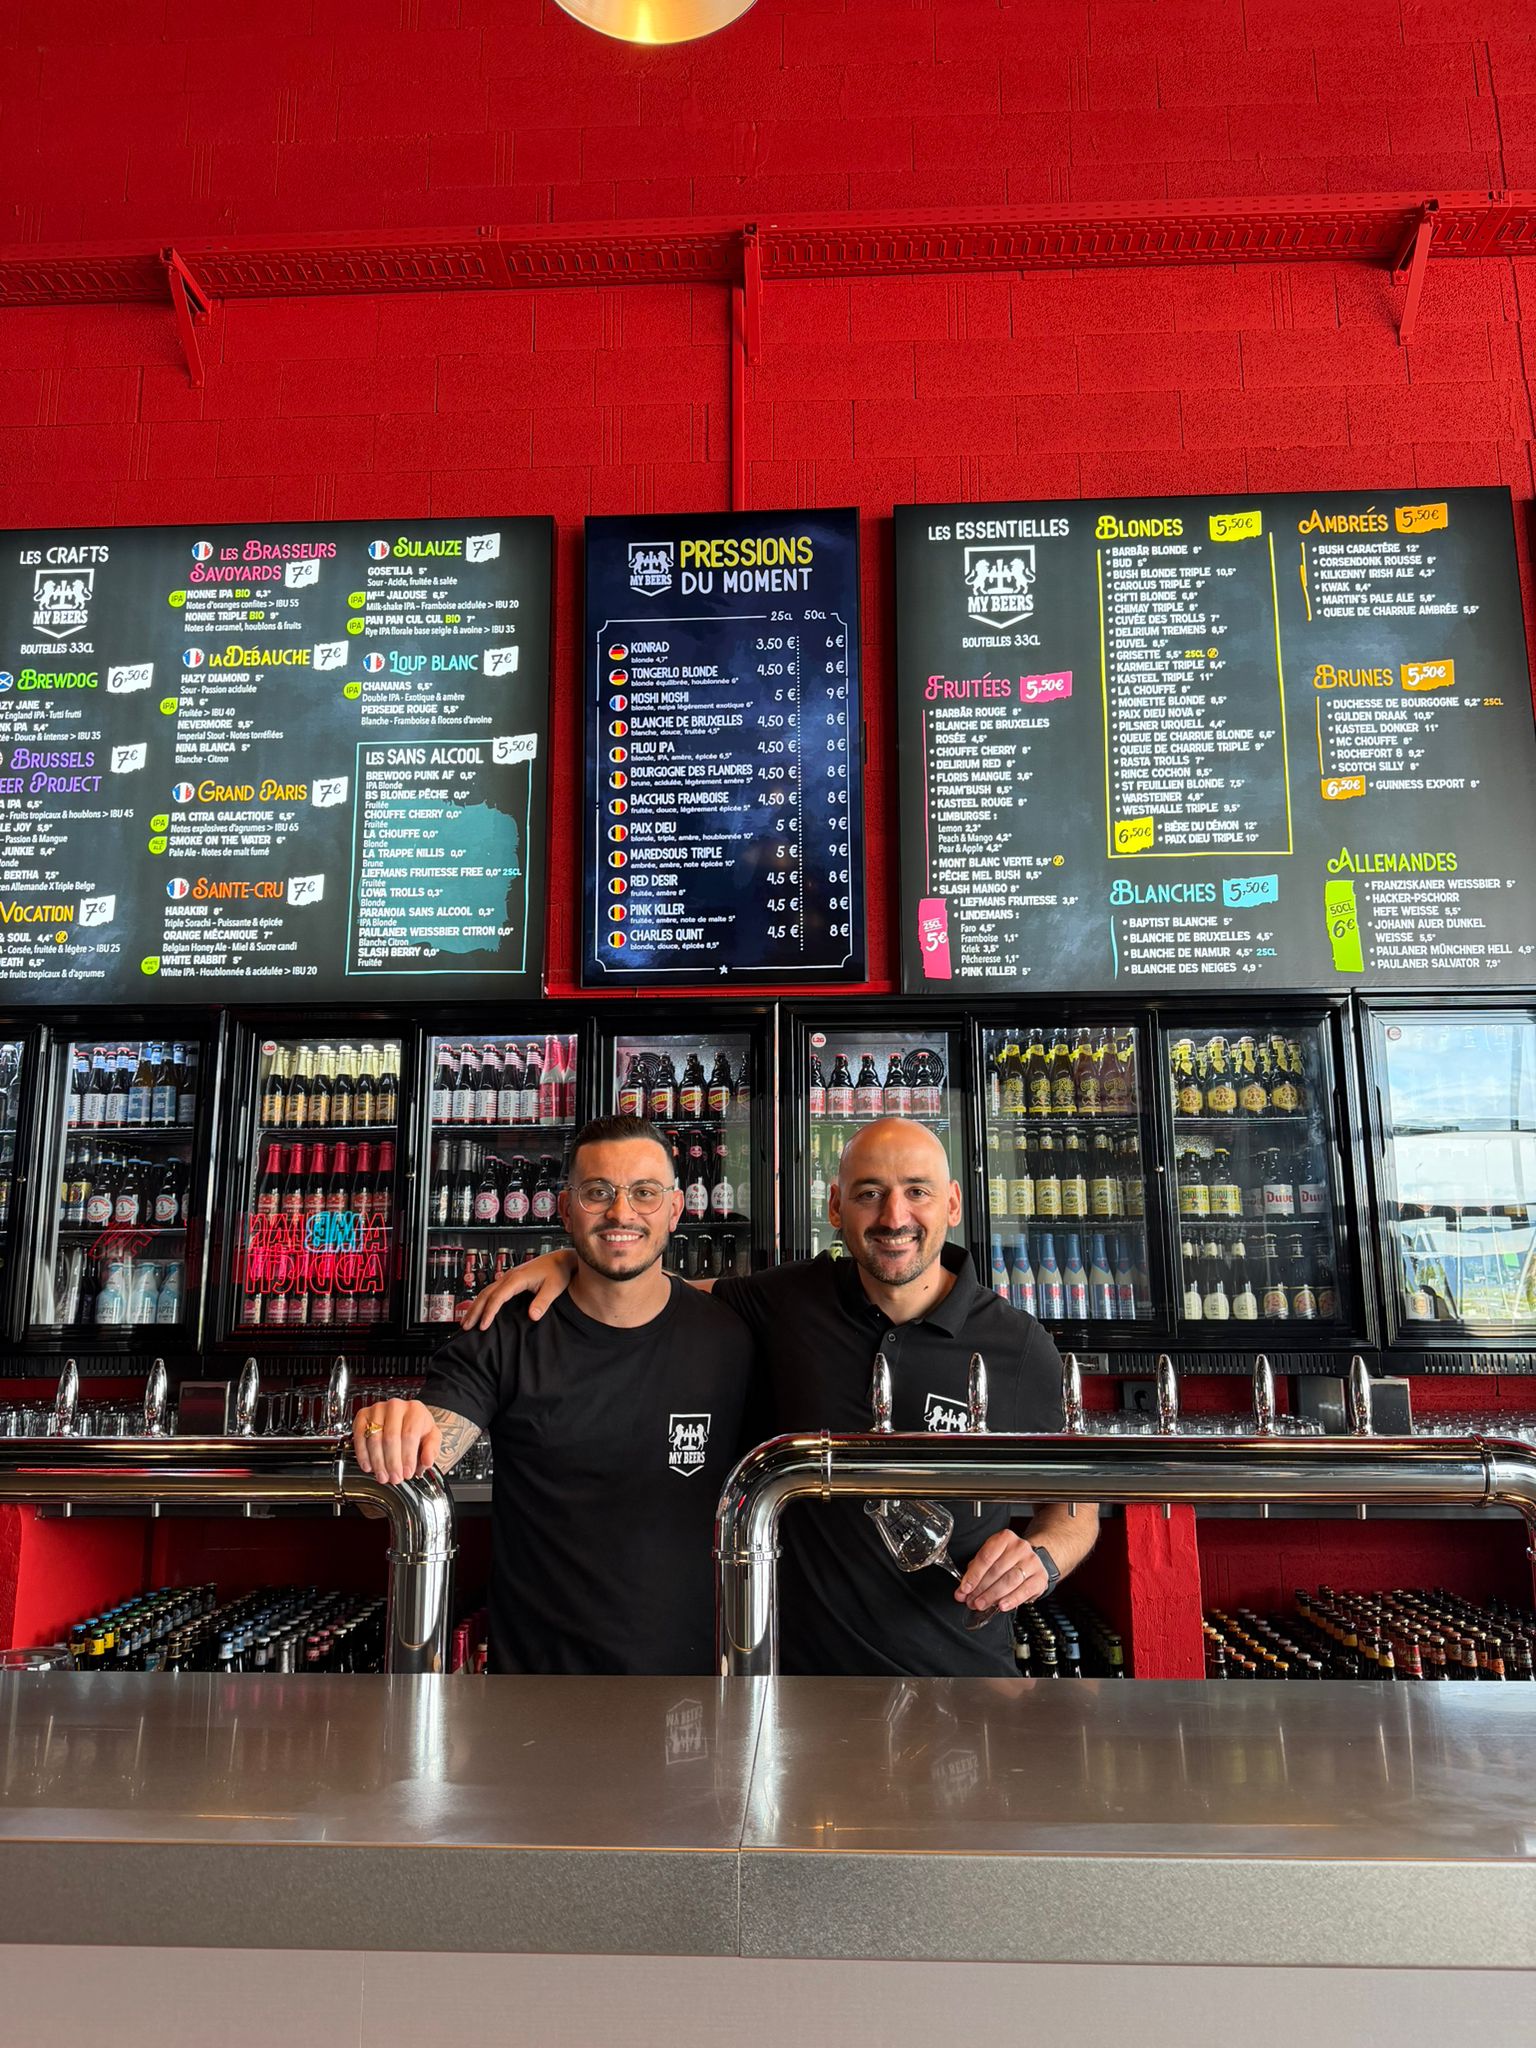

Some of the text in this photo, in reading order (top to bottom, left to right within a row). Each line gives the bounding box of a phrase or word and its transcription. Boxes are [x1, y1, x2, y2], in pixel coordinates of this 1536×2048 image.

[928, 518, 1070, 540] LES ESSENTIELLES
[1095, 516, 1183, 539] BLONDES
[220, 540, 337, 561] LES BRASSEURS
[393, 537, 463, 558] SULAUZE
[473, 539, 494, 558] 7€
[680, 536, 813, 568] PRESSIONS
[20, 546, 109, 564] LES CRAFTS
[190, 562, 282, 582] SAVOYARDS
[292, 565, 312, 583] 7€
[630, 574, 672, 586] MY BEERS
[681, 567, 813, 595] DU MOMENT
[1321, 582, 1350, 592] KWAK
[171, 594, 183, 603] IPA
[187, 590, 217, 599] NONNE
[219, 589, 233, 599] IPA
[235, 589, 250, 598] BIO
[1322, 593, 1414, 605] MARTIN'S PALE ALE
[968, 594, 1033, 613] MY BEERS
[33, 610, 88, 625] MY BEERS
[20, 643, 67, 655] BOUTEILLES
[631, 641, 670, 654] KONRAD
[962, 637, 1012, 648] BOUTEILLES
[1116, 639, 1147, 648] DUVEL
[209, 654, 222, 667] LA
[320, 647, 341, 666] 7€
[389, 651, 479, 676] LOUP BLANC
[491, 653, 512, 672] 7€
[17, 669, 98, 690] BREWDOG
[181, 674, 206, 683] HAZY
[208, 673, 250, 683] DIAMOND
[631, 667, 680, 679] TONGERLO
[682, 666, 719, 678] BLONDE
[1313, 664, 1394, 689] BRUNES
[362, 682, 412, 691] CHANANAS
[925, 672, 1012, 700] FRUITÉES
[631, 692, 689, 704] MOSHI MOSHI
[1333, 699, 1383, 709] DUCHESSE
[1386, 699, 1399, 708] DE
[1401, 697, 1459, 708] BOURGOGNE
[406, 704, 438, 714] ROUGE
[630, 714, 743, 729] BLANCHE DE BRUXELLES
[1119, 720, 1204, 731] PILSNER URQUELL
[630, 741, 675, 754] FILOU IPA
[10, 748, 95, 769] BRUSSELS
[117, 749, 139, 769] 7€
[365, 747, 484, 766] LES SANS ALCOOL
[630, 764, 753, 778] BOURGOGNE DES FLANDRES
[0, 771, 102, 794] EER PROJECT
[1376, 779, 1464, 790] GUINNESS EXPORT
[197, 779, 307, 802] GRAND PARIS
[320, 783, 341, 803] 7€
[630, 792, 729, 806] BACCHUS FRAMBOISE
[630, 822, 677, 834] PAIX DIEU
[630, 847, 723, 861] MAREDSOUS TRIPLE
[1326, 847, 1457, 873] ALLEMANDES
[939, 856, 1033, 868] MONT BLANC VERTE
[361, 868, 408, 878] LIEFMANS
[409, 867, 459, 877] FRUITESSE
[460, 867, 484, 877] FREE
[630, 874, 678, 887] RED DESIR
[1371, 880, 1445, 890] FRANZISKANER
[1447, 879, 1501, 889] WEISSBIER
[192, 877, 284, 899] SAINTE-CRU
[294, 881, 316, 901] 7€
[1110, 880, 1216, 905] BLANCHES
[1372, 893, 1459, 903] HACKER-PSCHORR
[0, 901, 74, 924] VOCATION
[86, 902, 107, 922] 7€
[630, 903, 685, 916] PINK KILLER
[1330, 903, 1353, 915] 50CL
[1129, 917, 1169, 927] BAPTIST
[1172, 917, 1217, 926] BLANCHE
[1332, 918, 1355, 939] 6€
[163, 928, 258, 941] ORANGE MÉCANIQUE
[358, 927, 407, 938] PAULANER
[410, 927, 460, 937] WEISSBIER
[462, 926, 496, 936] CITRON
[629, 928, 704, 942] CHARLES QUINT
[925, 931, 947, 952] 5€
[162, 954, 227, 965] WHITE RABBIT
[1130, 948, 1175, 958] BLANCHE
[1177, 948, 1192, 957] DE
[1194, 947, 1231, 957] NAMUR
[1377, 958, 1480, 969] PAULANER SALVATOR
[669, 1451, 705, 1464] MY BEERS
